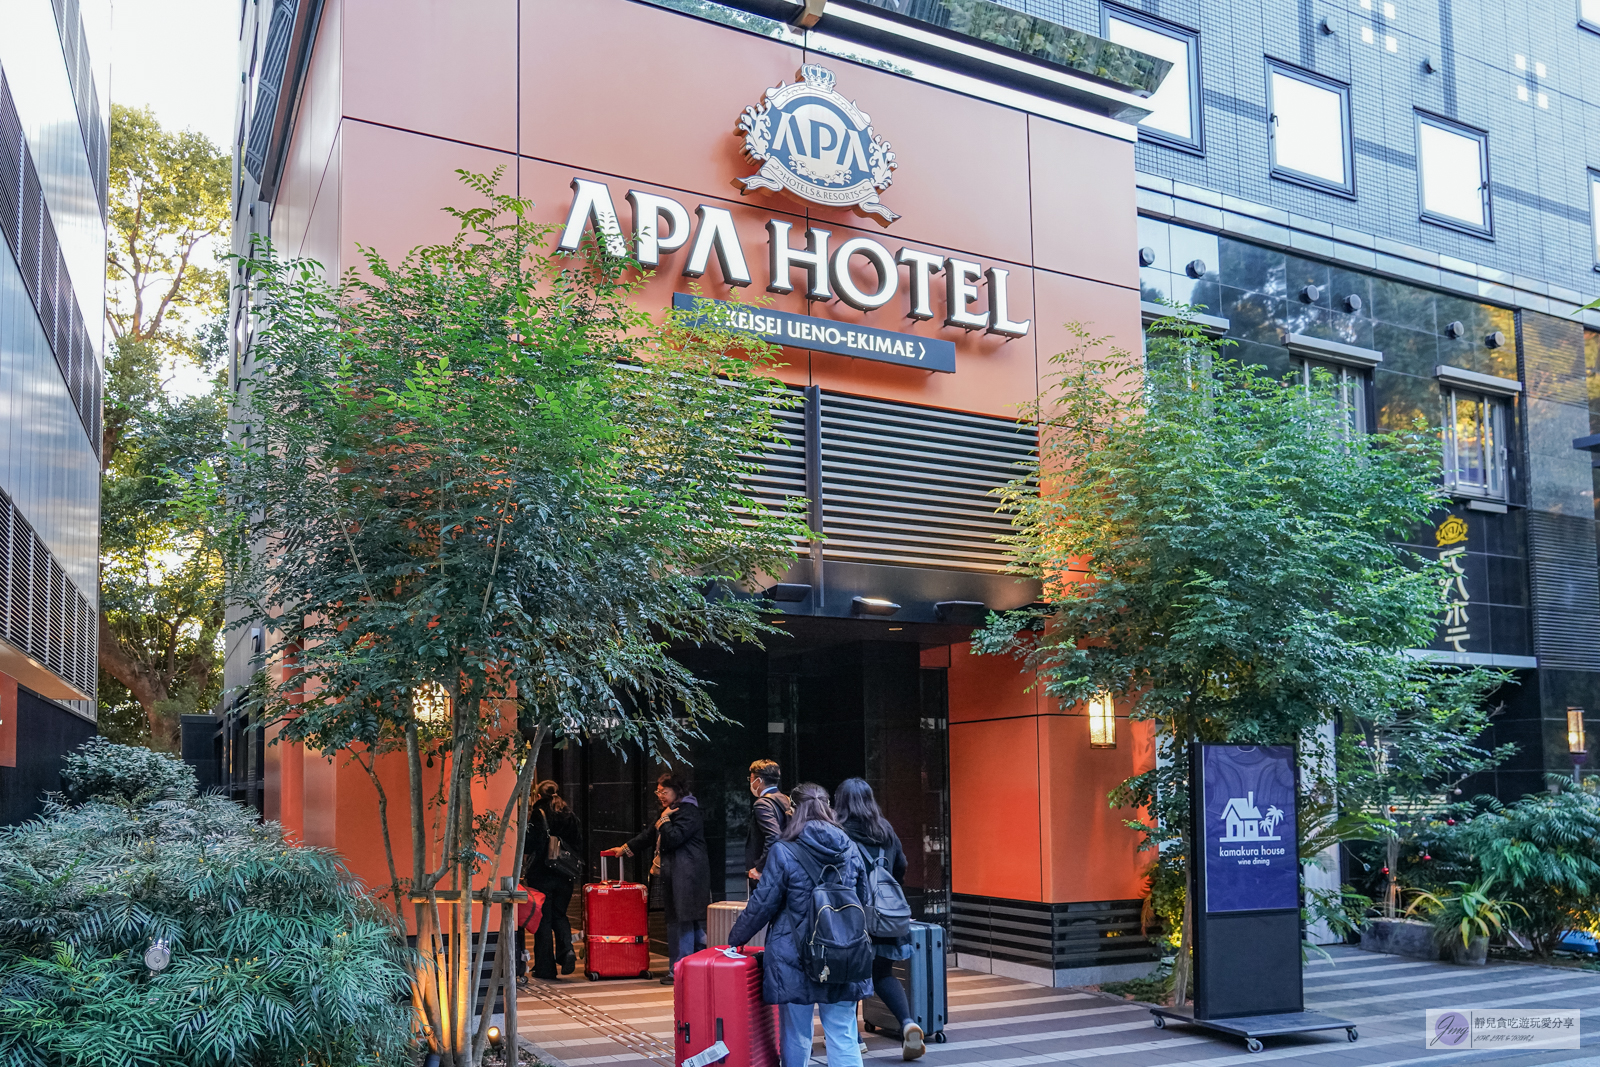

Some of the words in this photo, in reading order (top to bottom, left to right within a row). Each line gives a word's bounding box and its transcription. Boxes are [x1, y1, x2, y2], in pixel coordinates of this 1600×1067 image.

[772, 111, 869, 172] APA
[558, 178, 751, 287] APA
[765, 219, 1031, 338] HOTEL
[725, 310, 782, 335] KEISEI
[1219, 846, 1259, 857] kamakura
[1261, 845, 1285, 856] house
[1252, 857, 1270, 866] dining
